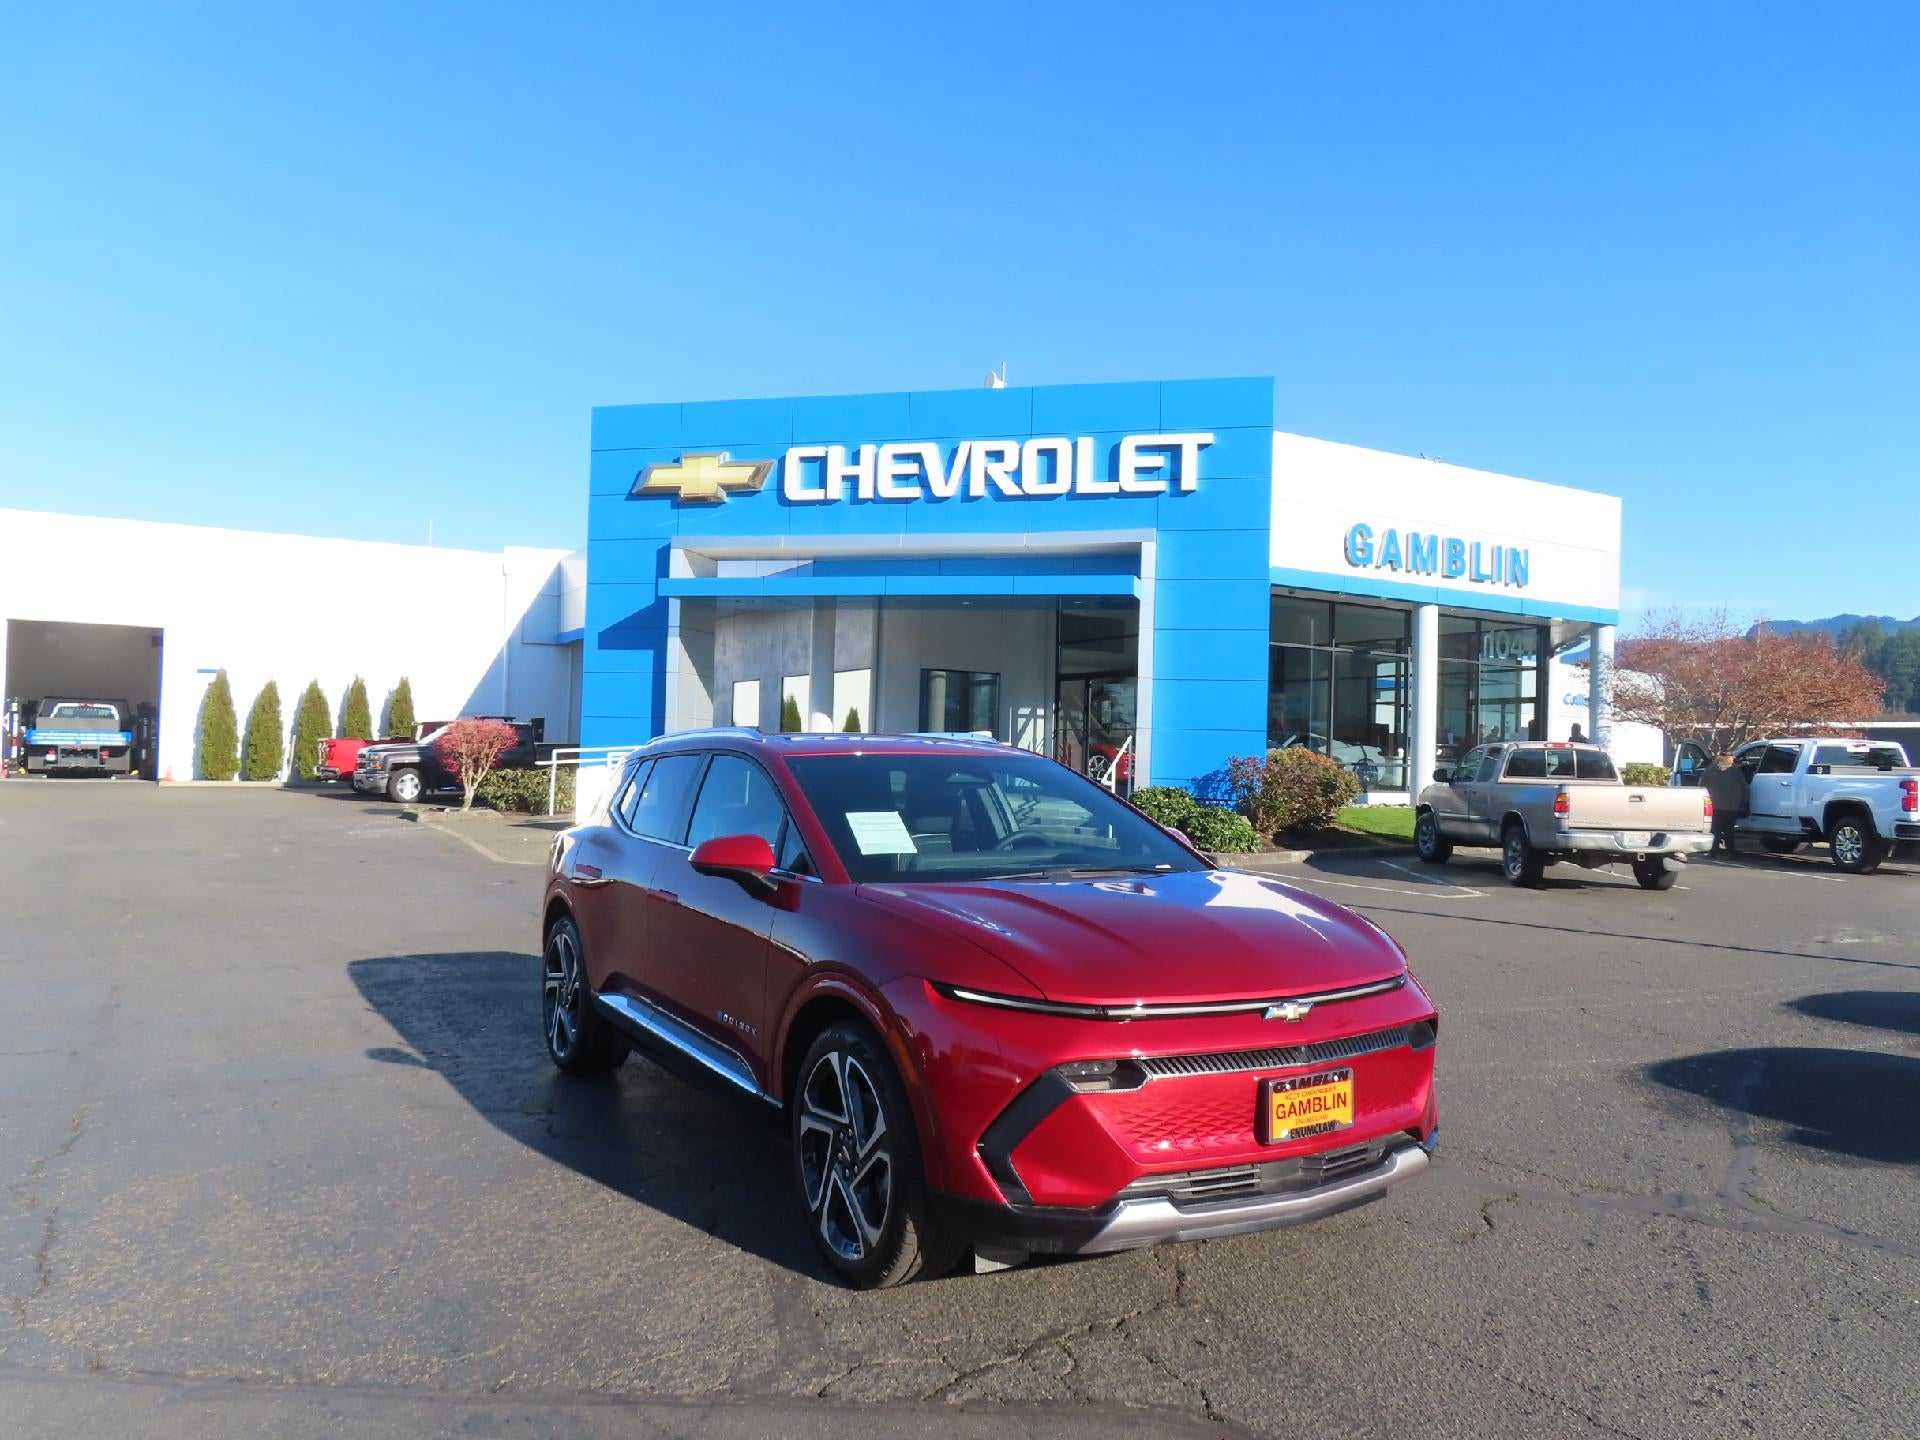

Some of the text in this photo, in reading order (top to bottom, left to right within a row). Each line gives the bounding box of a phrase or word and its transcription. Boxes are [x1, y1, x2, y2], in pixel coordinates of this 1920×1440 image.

[783, 432, 1215, 503] CHEVROLET
[1344, 522, 1529, 588] GAMBLIN
[1273, 1070, 1349, 1093] GAMBLIN
[1275, 1092, 1347, 1119] GAMBLIN
[1290, 1119, 1337, 1139] ENUMCLAW
